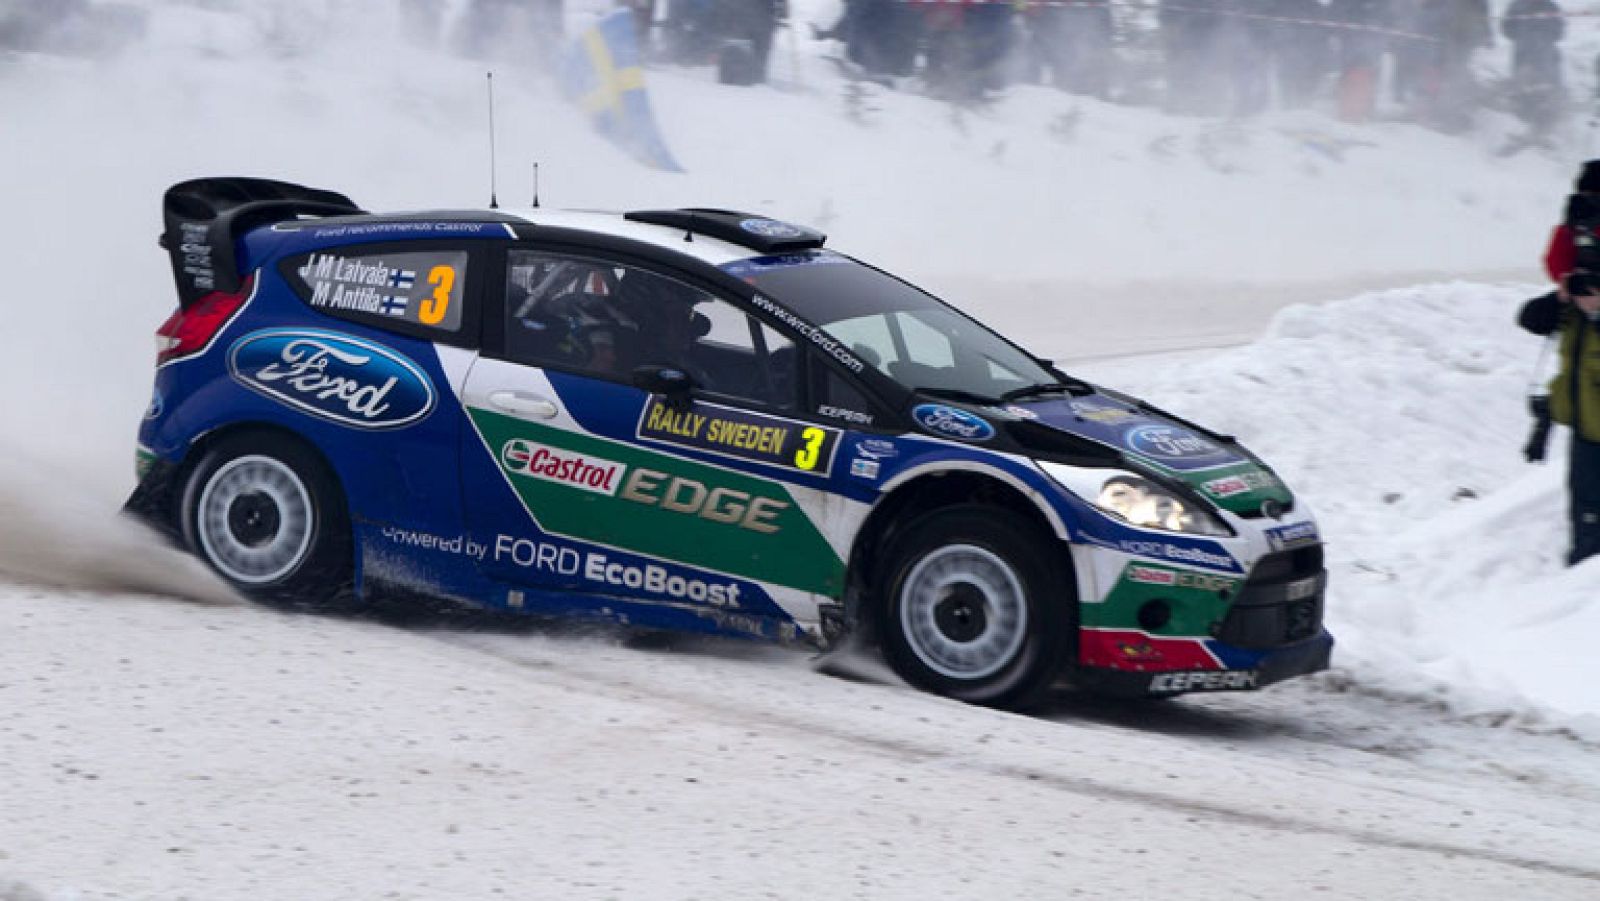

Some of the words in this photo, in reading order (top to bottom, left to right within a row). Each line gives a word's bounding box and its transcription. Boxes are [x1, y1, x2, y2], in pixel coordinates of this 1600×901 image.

[311, 281, 332, 305] M
[330, 283, 381, 312] Anttila
[316, 254, 335, 278] M
[334, 256, 389, 286] Latvala
[418, 264, 455, 325] 3
[752, 294, 863, 372] www.wrcford.com
[256, 340, 398, 417] Ford
[647, 404, 703, 439] RALLY
[707, 419, 787, 455] SWEDEN
[794, 426, 825, 470] 3
[925, 405, 980, 437] Ford
[529, 448, 616, 491] Castrol
[621, 468, 789, 533] EDGE
[466, 540, 487, 561] by
[494, 534, 580, 575] FORD
[585, 555, 741, 608] EcoBoost
